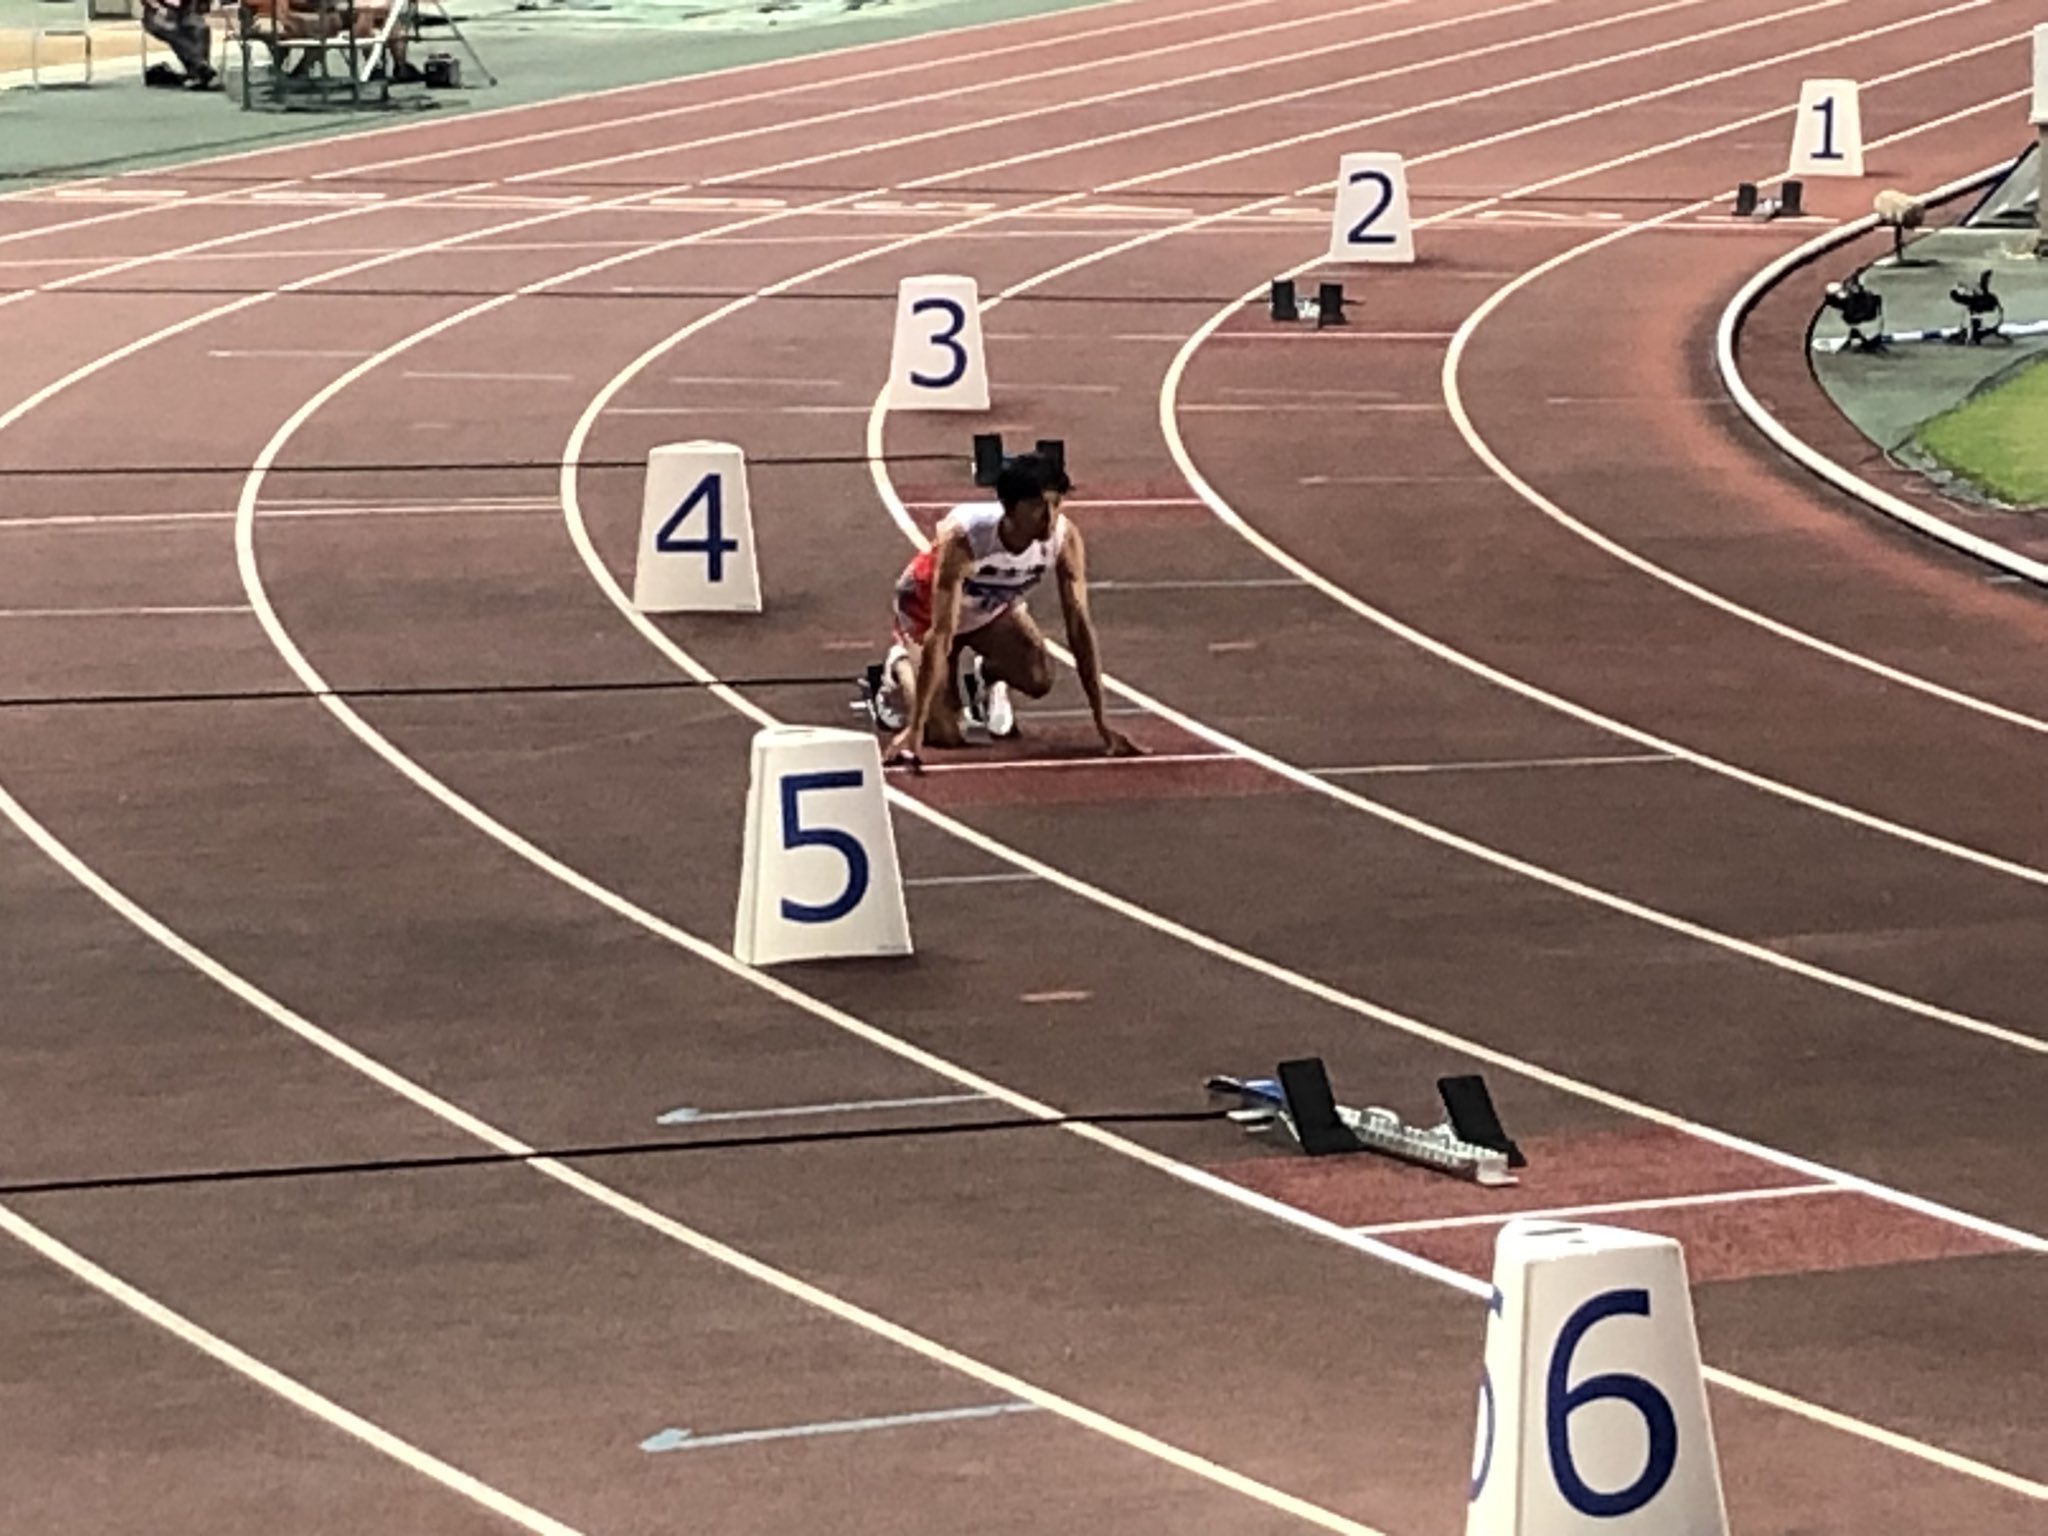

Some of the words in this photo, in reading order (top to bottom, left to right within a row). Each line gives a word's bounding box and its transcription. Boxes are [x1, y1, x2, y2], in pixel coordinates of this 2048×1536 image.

[1810, 96, 1844, 159] 1
[1347, 170, 1397, 245] 2
[911, 297, 968, 388] 3
[657, 475, 739, 583] 4
[781, 770, 869, 923] 5
[1546, 1288, 1678, 1518] 6
